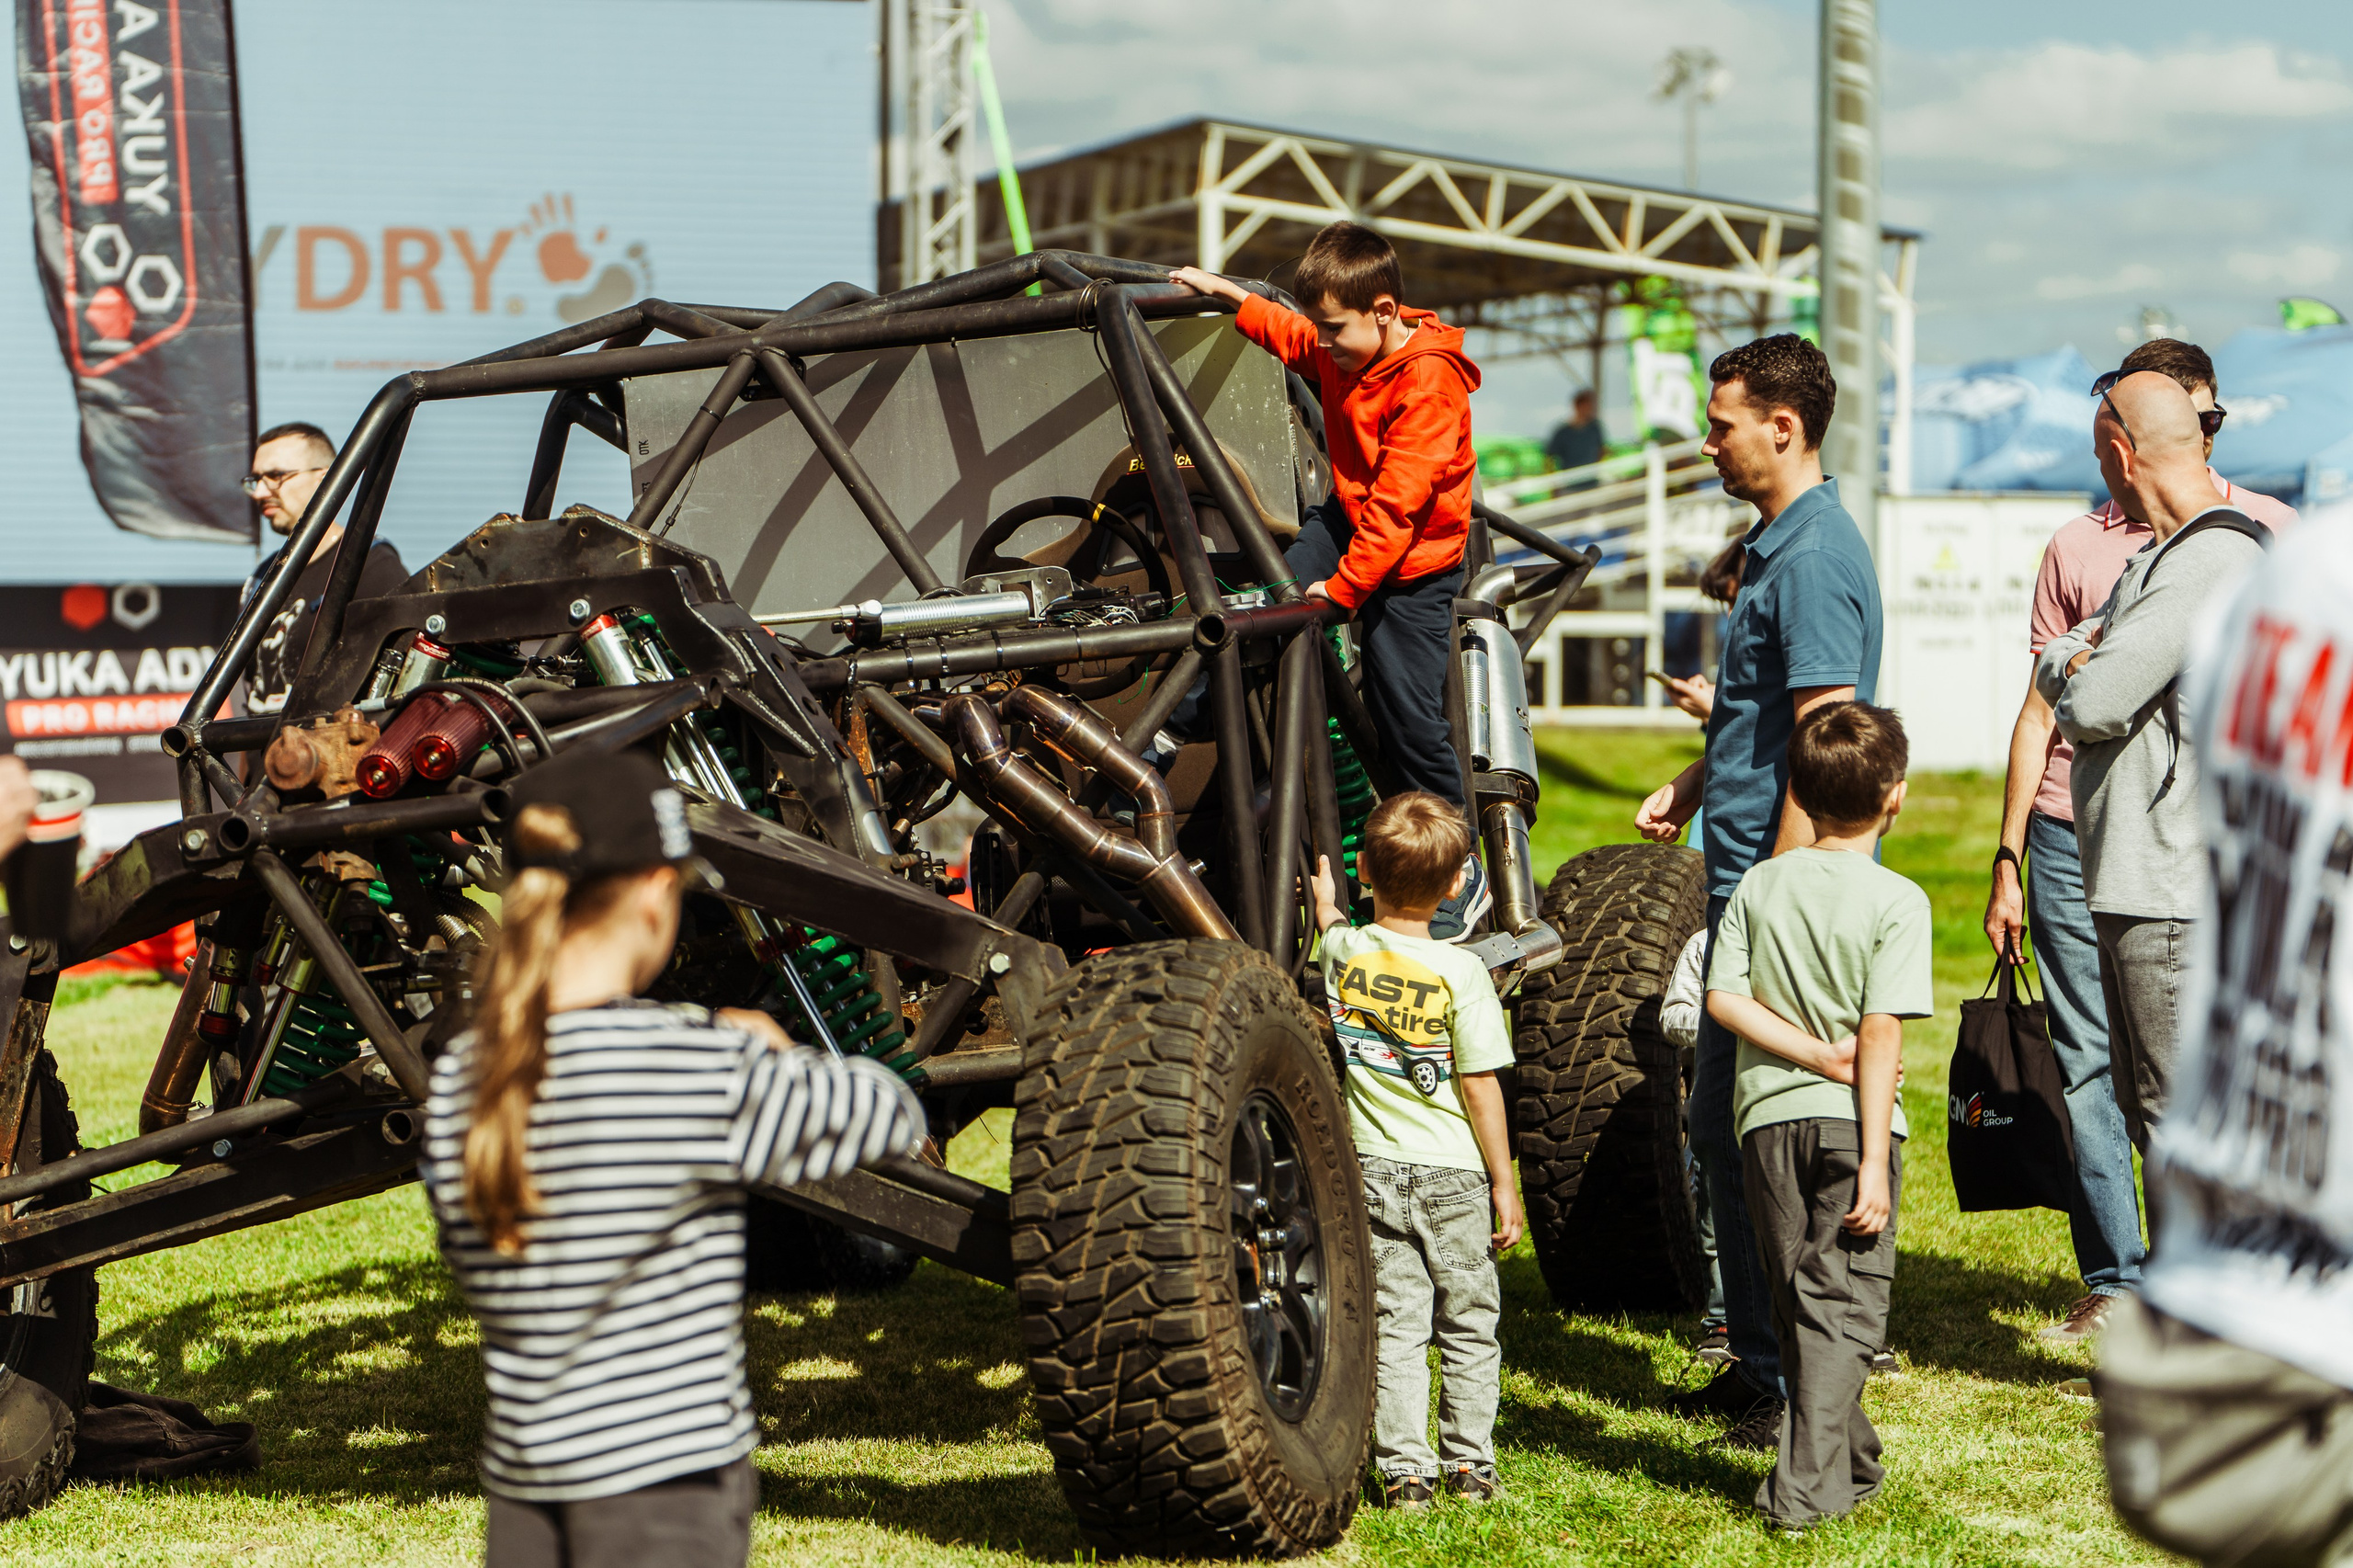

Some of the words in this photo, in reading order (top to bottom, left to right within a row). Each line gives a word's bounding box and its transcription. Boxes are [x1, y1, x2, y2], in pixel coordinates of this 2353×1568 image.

[0, 649, 130, 700] YUKA
[21, 702, 89, 734] PRO
[1329, 958, 1440, 1009] FAST
[1384, 1006, 1445, 1035] tire
[1983, 1108, 1997, 1118] OIL
[1983, 1116, 2014, 1127] GROUP
